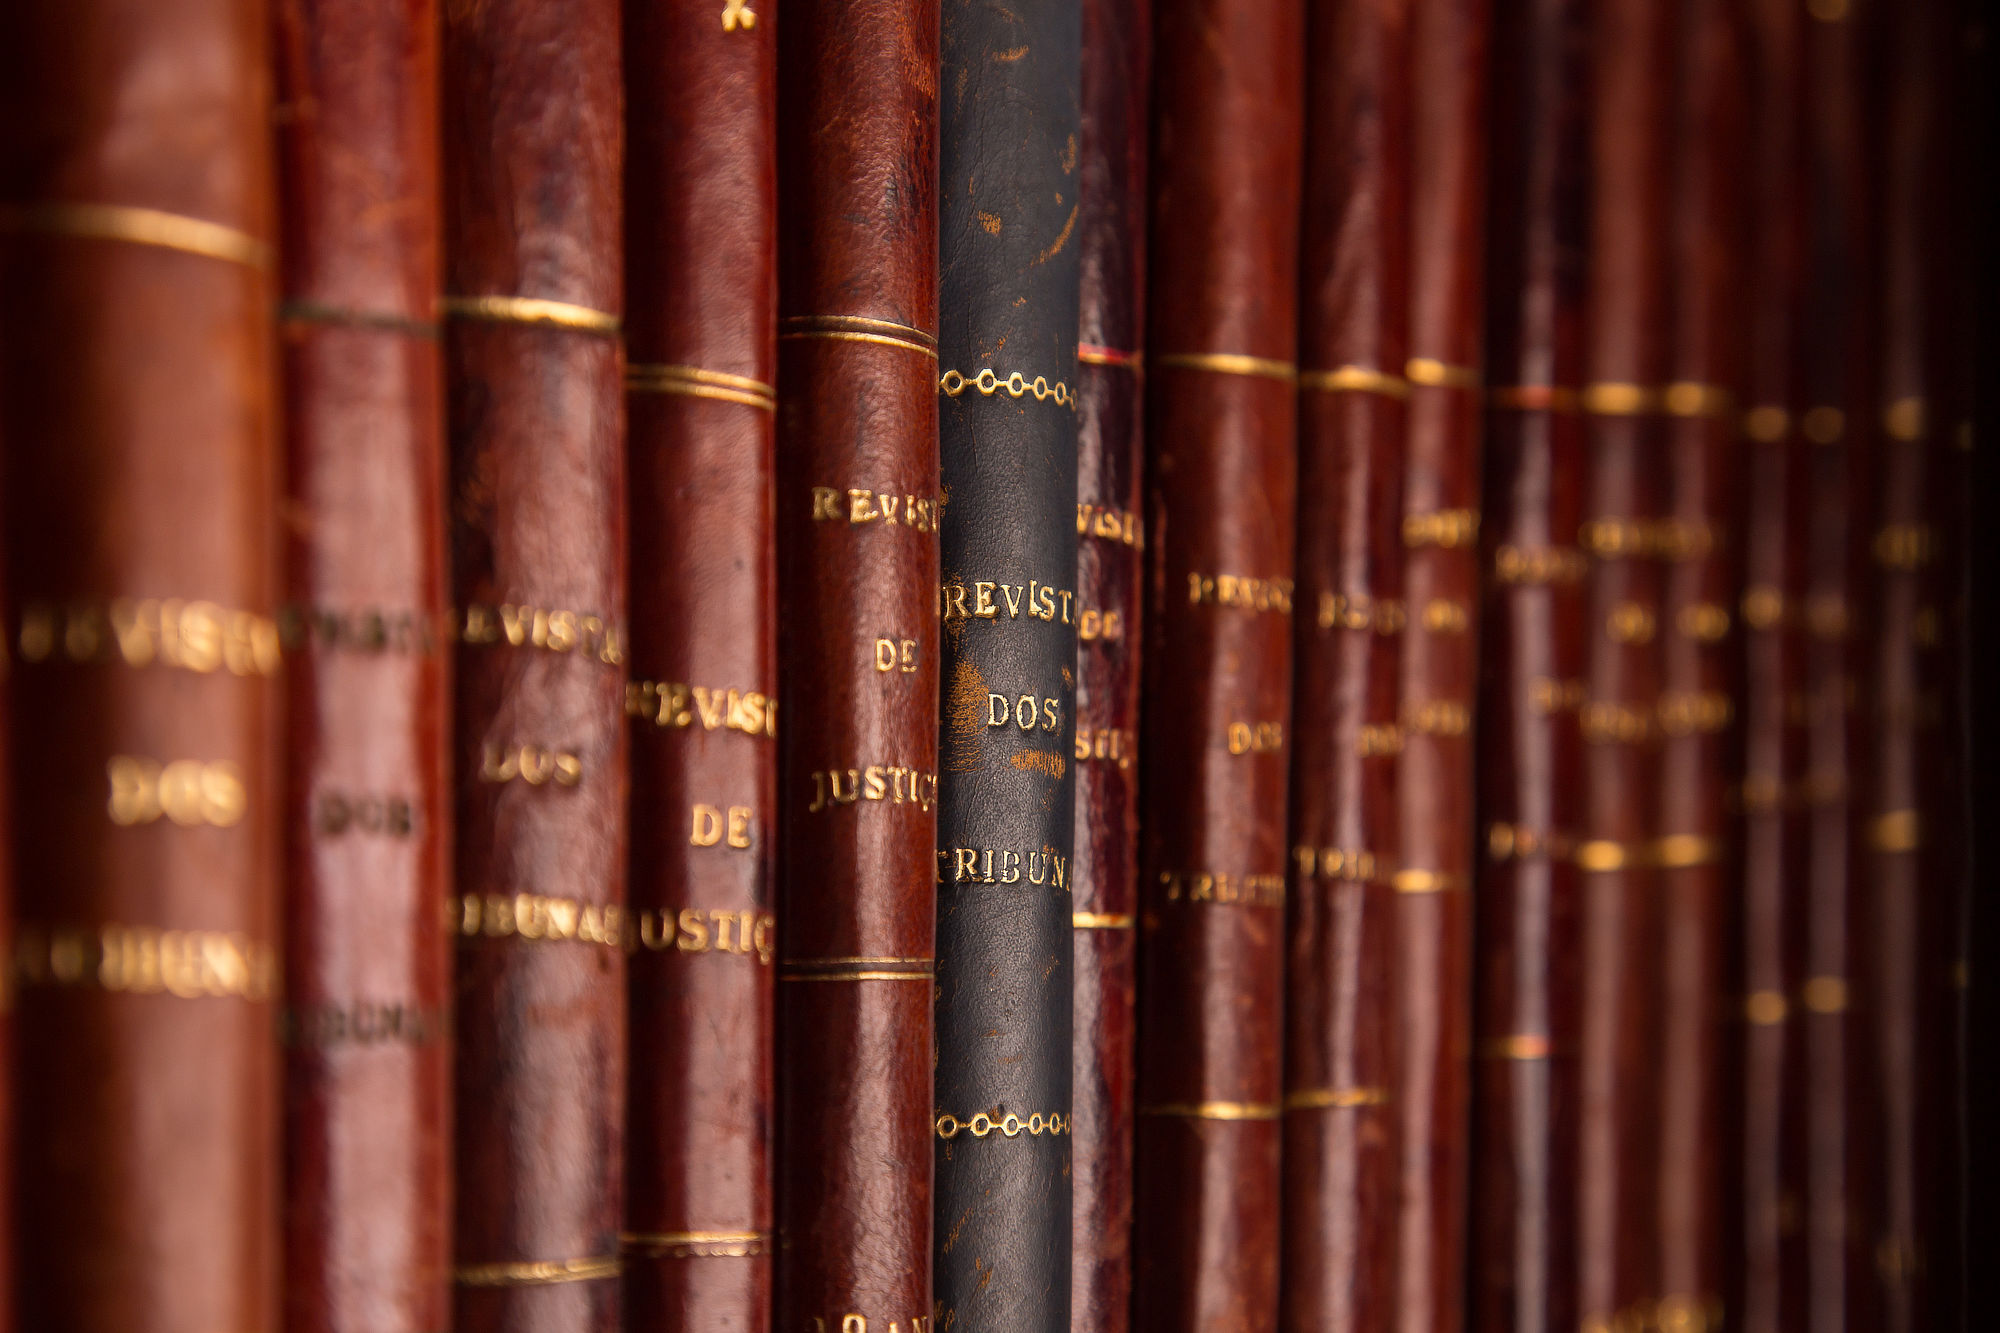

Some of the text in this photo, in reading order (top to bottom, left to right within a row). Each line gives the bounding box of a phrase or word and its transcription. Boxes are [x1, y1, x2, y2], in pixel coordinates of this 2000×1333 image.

[942, 580, 1077, 624] REVIST
[876, 639, 918, 672] DE
[987, 694, 1059, 731] DOS
[108, 756, 246, 828] DOS
[690, 803, 752, 848] DE
[936, 848, 1072, 892] TRIBUN
[638, 907, 775, 965] USTIÇ
